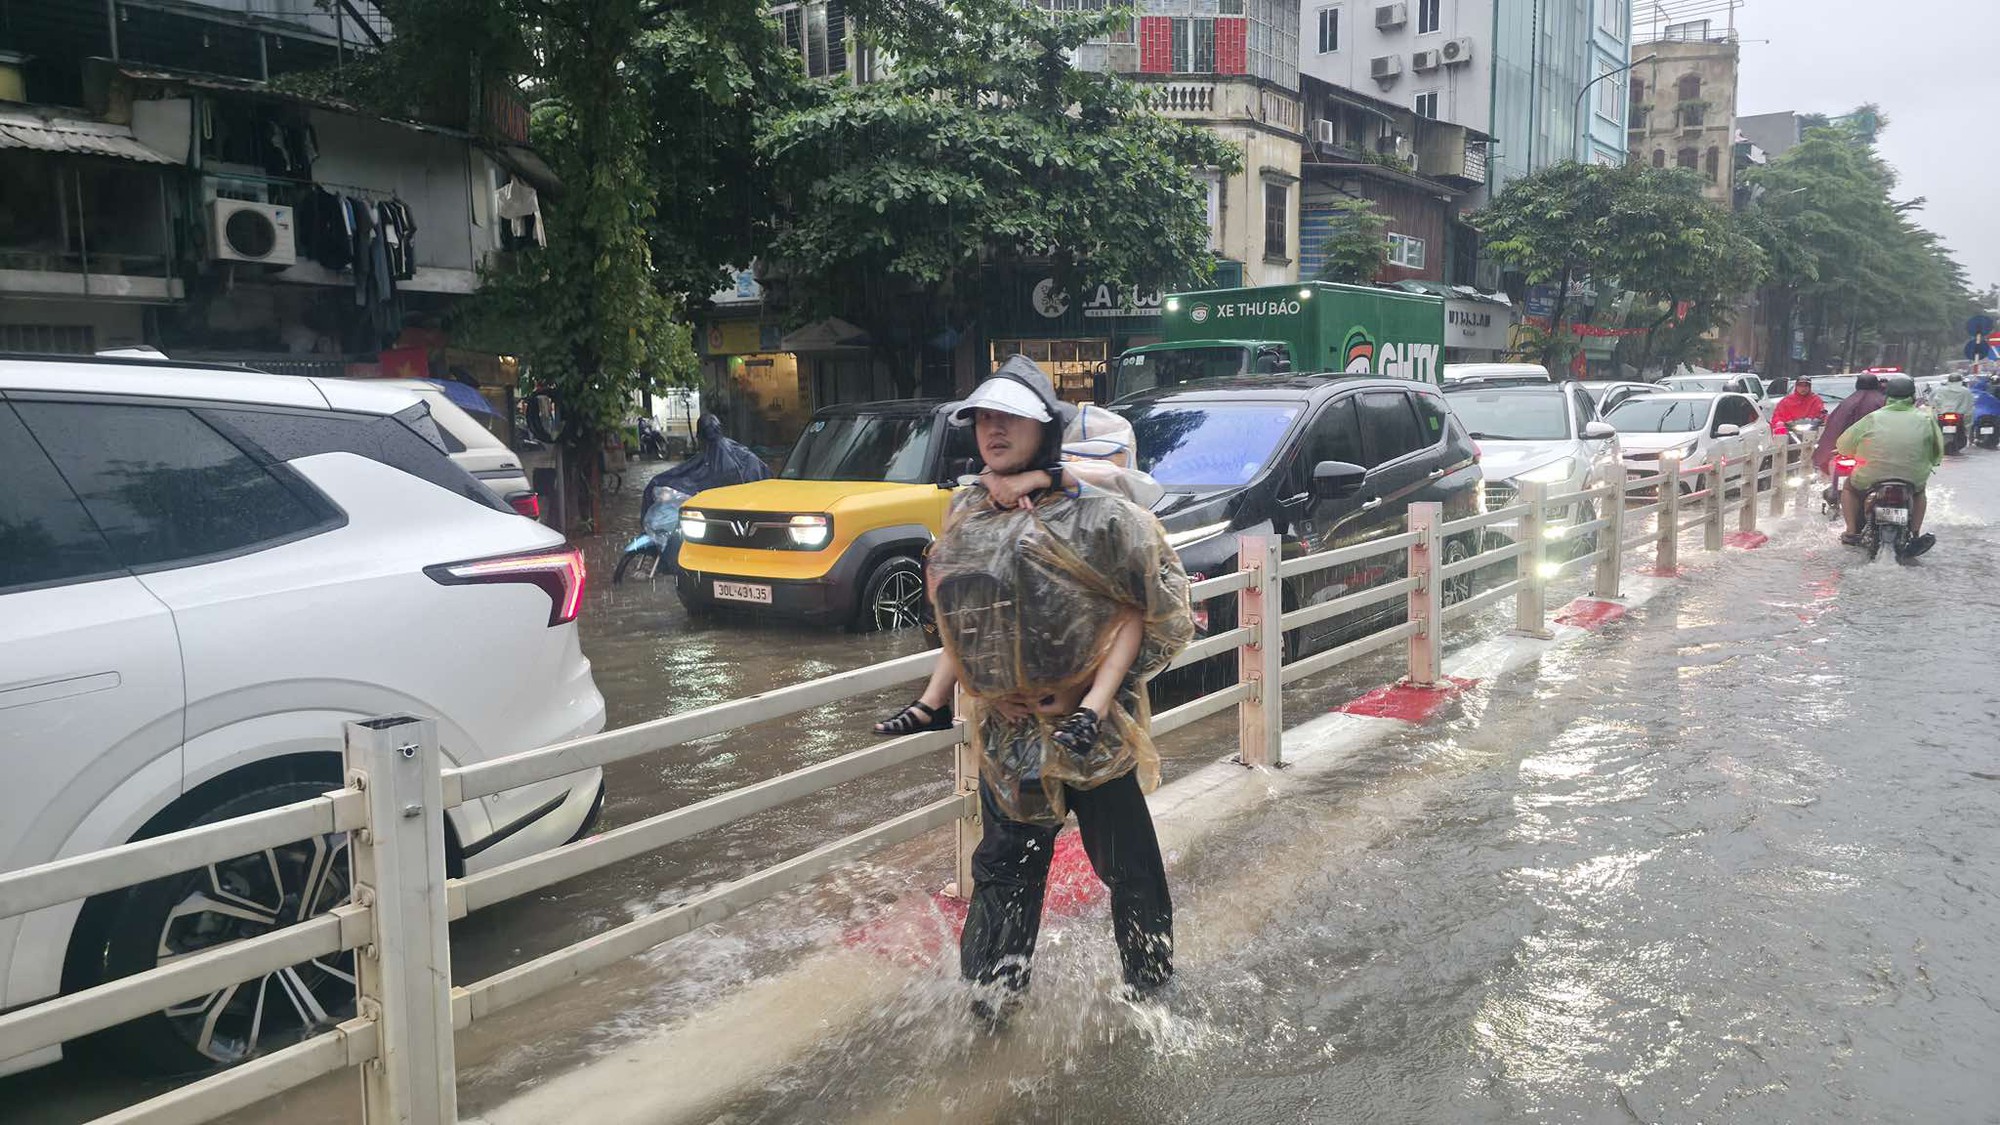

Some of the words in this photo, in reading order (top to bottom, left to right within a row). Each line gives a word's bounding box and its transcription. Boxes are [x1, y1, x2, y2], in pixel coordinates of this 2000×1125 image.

[1217, 304, 1234, 318] XE
[1237, 301, 1267, 316] THƯ
[1268, 298, 1300, 315] BÁO
[1378, 342, 1439, 385] GHTK
